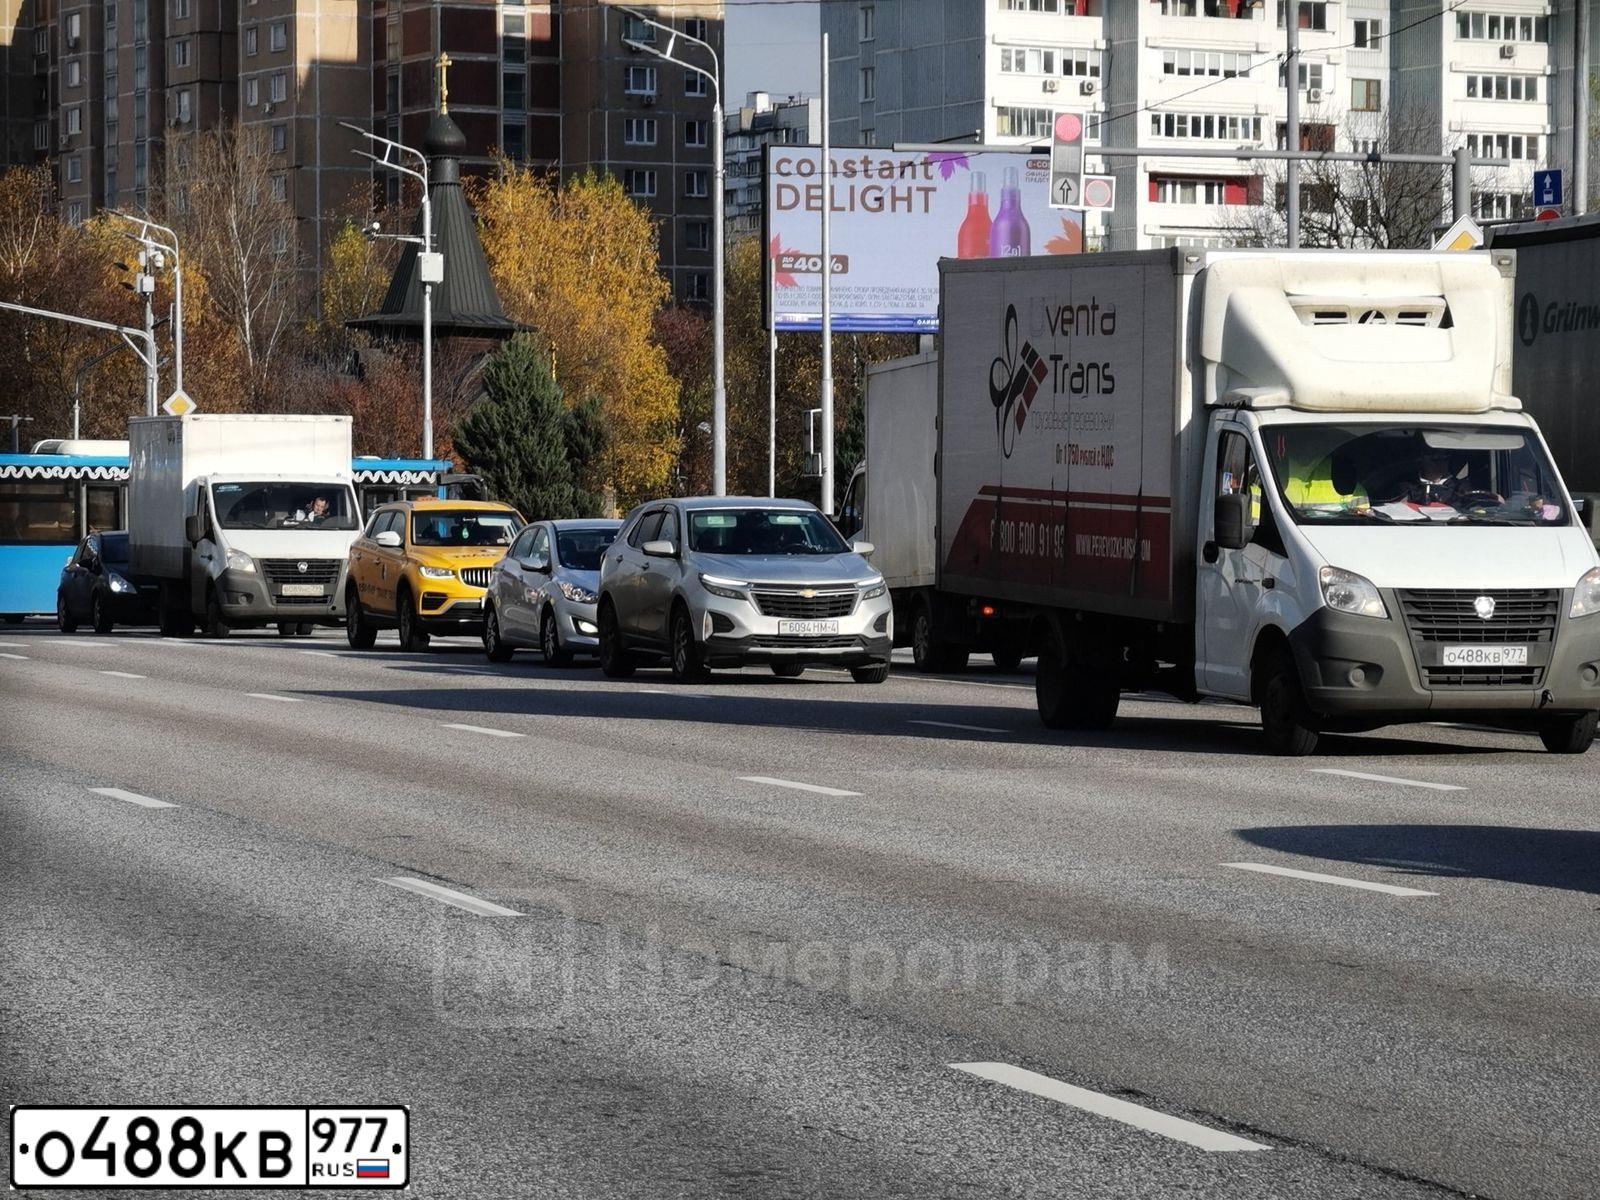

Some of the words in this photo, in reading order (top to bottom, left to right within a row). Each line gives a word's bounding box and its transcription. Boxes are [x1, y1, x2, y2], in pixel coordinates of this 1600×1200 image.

[775, 154, 934, 180] constant
[776, 184, 937, 214] DELIGHT
[1049, 354, 1116, 395] Trans
[1019, 521, 1035, 555] 500
[1039, 523, 1050, 558] 91
[1503, 648, 1524, 659] 977
